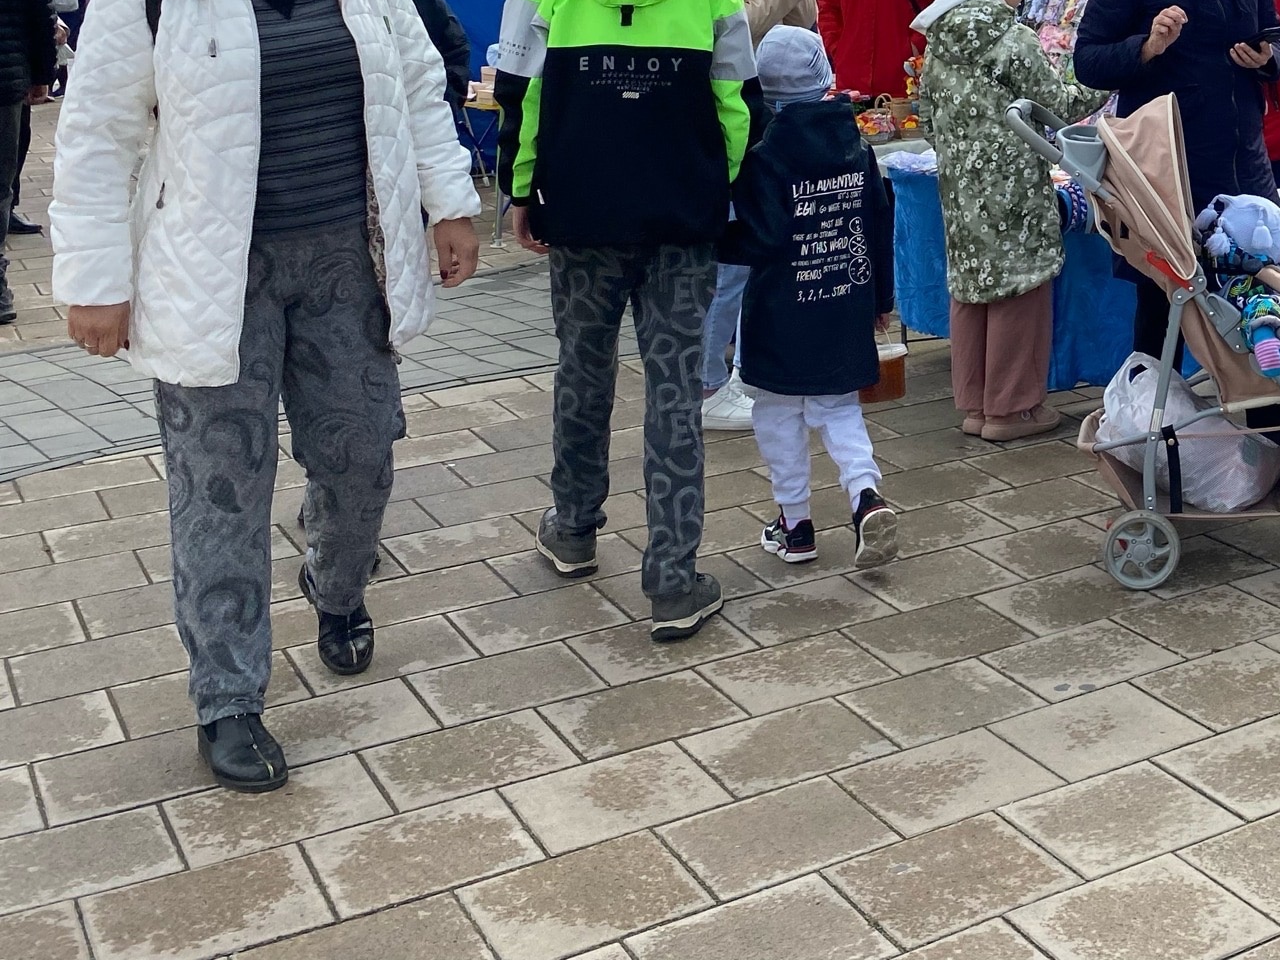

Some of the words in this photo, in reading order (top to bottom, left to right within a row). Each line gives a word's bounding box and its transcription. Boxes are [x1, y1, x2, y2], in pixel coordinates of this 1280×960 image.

[579, 55, 683, 72] ENJOY
[810, 240, 828, 255] THIS
[796, 269, 822, 282] FRIENDS
[831, 283, 852, 297] START
